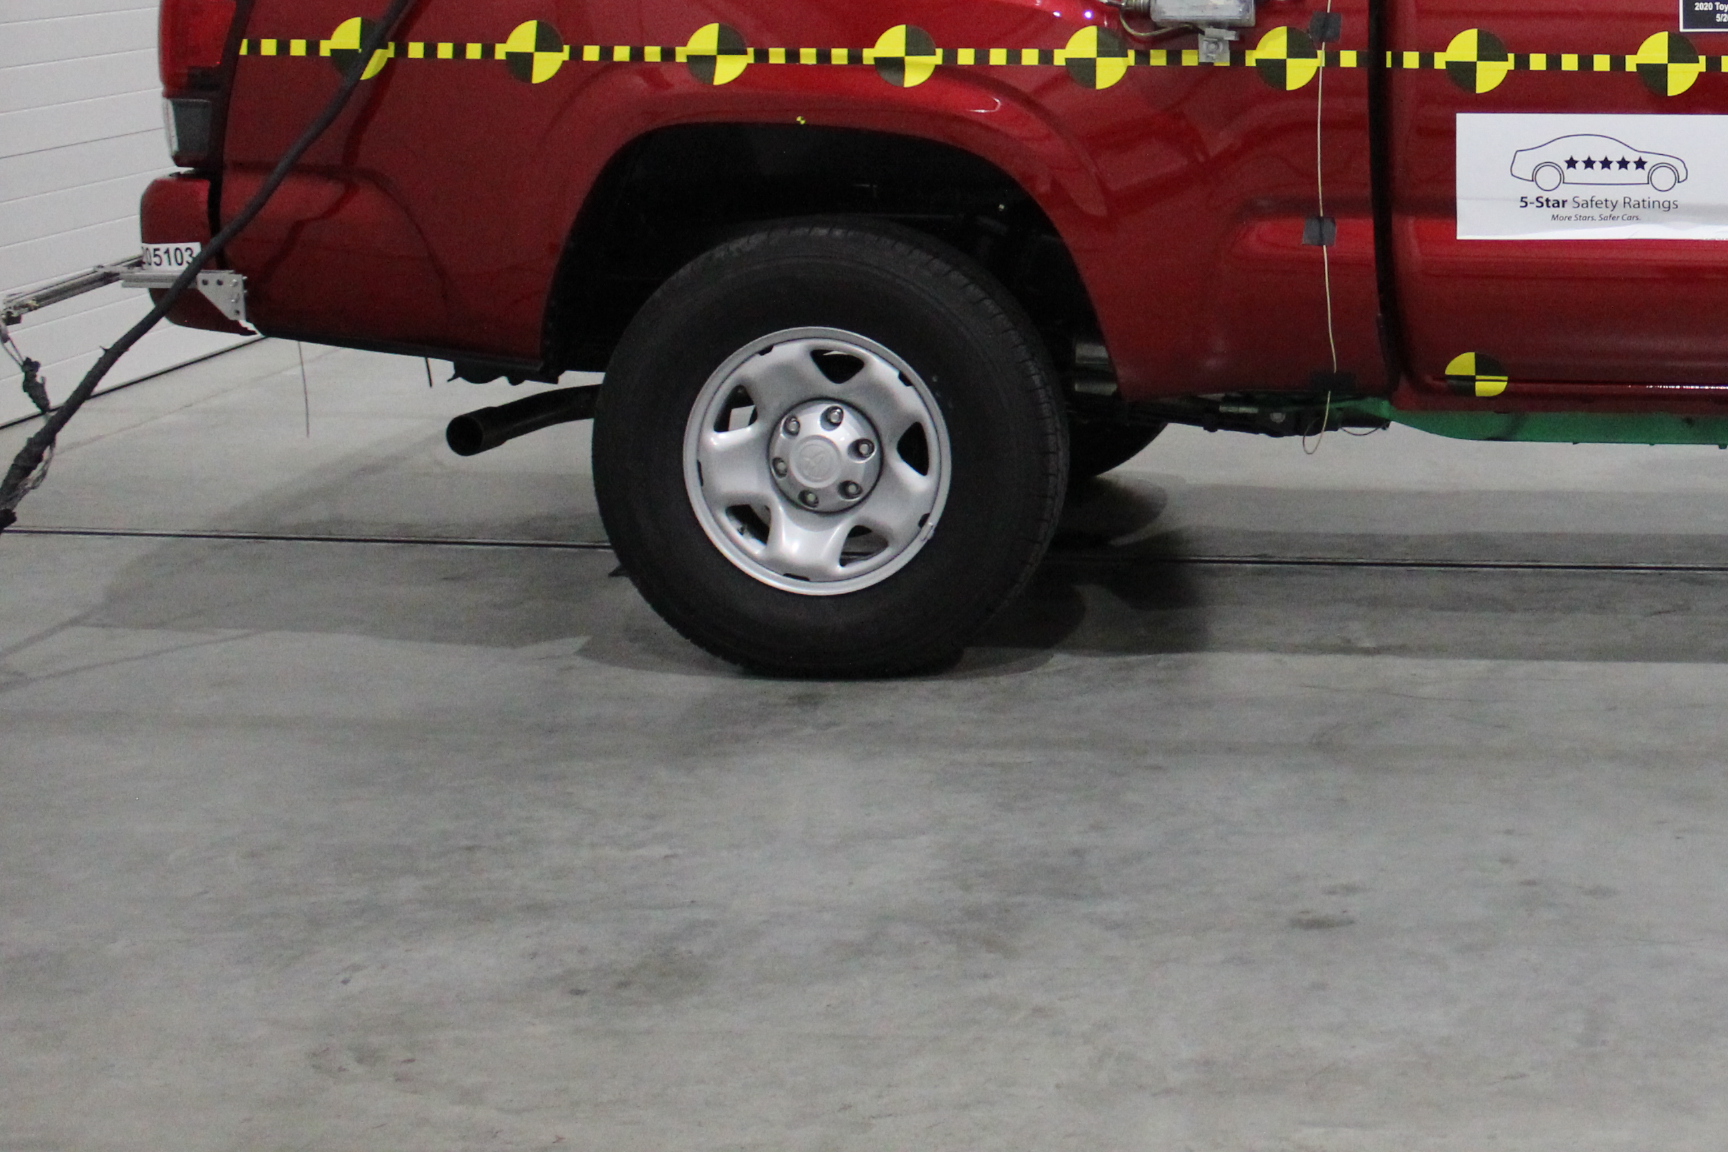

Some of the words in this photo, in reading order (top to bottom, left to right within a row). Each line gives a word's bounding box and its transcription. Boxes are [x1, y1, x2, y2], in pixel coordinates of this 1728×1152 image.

[1519, 196, 1568, 208] 5-Star
[1572, 196, 1618, 211] Safety
[1623, 196, 1678, 211] Ratings
[142, 247, 194, 266] 05103
